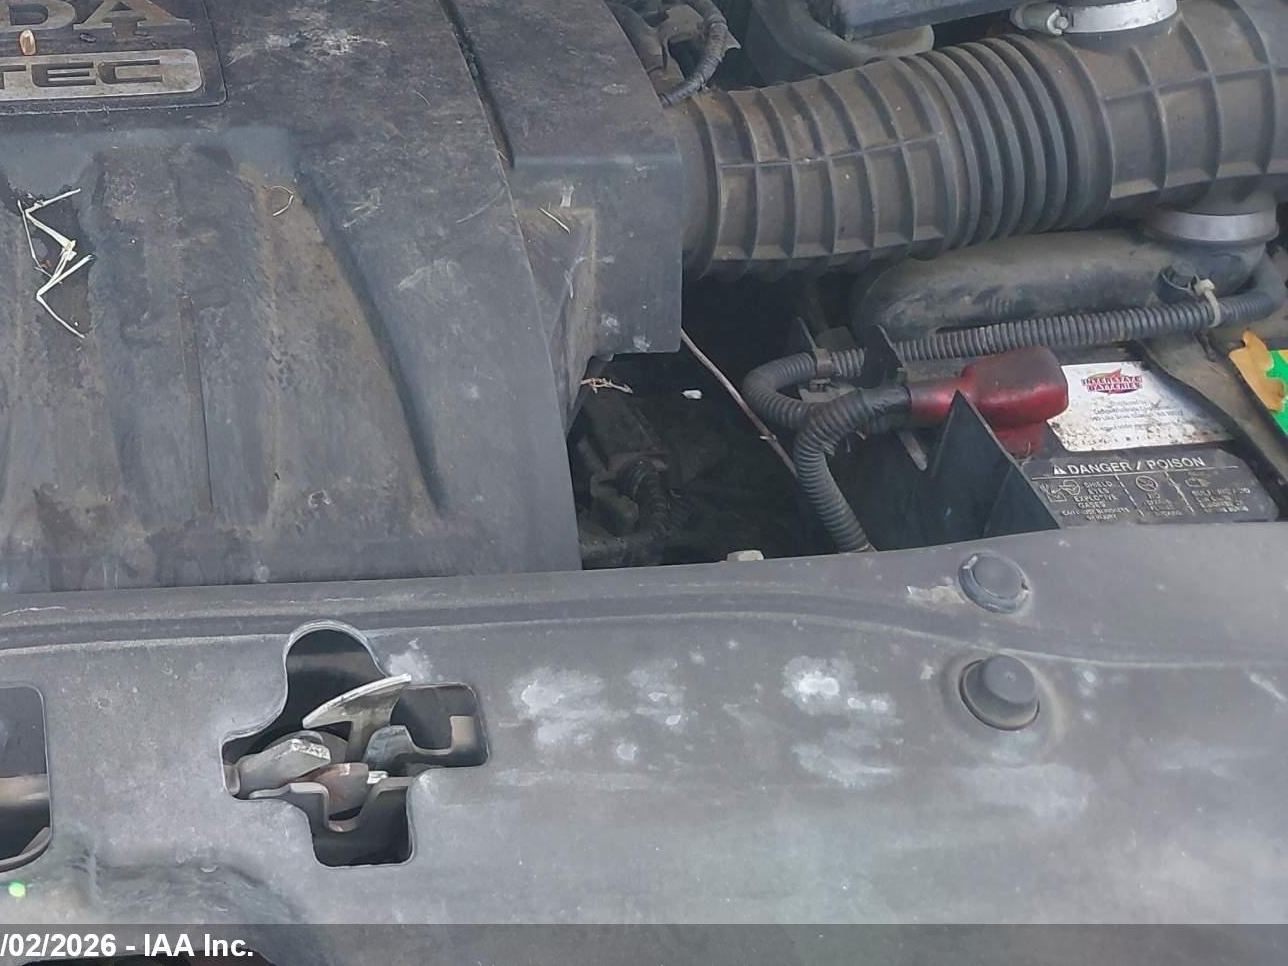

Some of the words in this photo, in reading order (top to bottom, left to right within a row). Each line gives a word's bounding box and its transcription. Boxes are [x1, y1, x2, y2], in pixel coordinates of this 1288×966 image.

[1080, 375, 1144, 386] INTERSTATE
[1086, 382, 1143, 392] BATTERIES
[1066, 461, 1133, 475] DANGER
[1145, 456, 1207, 470] POISON
